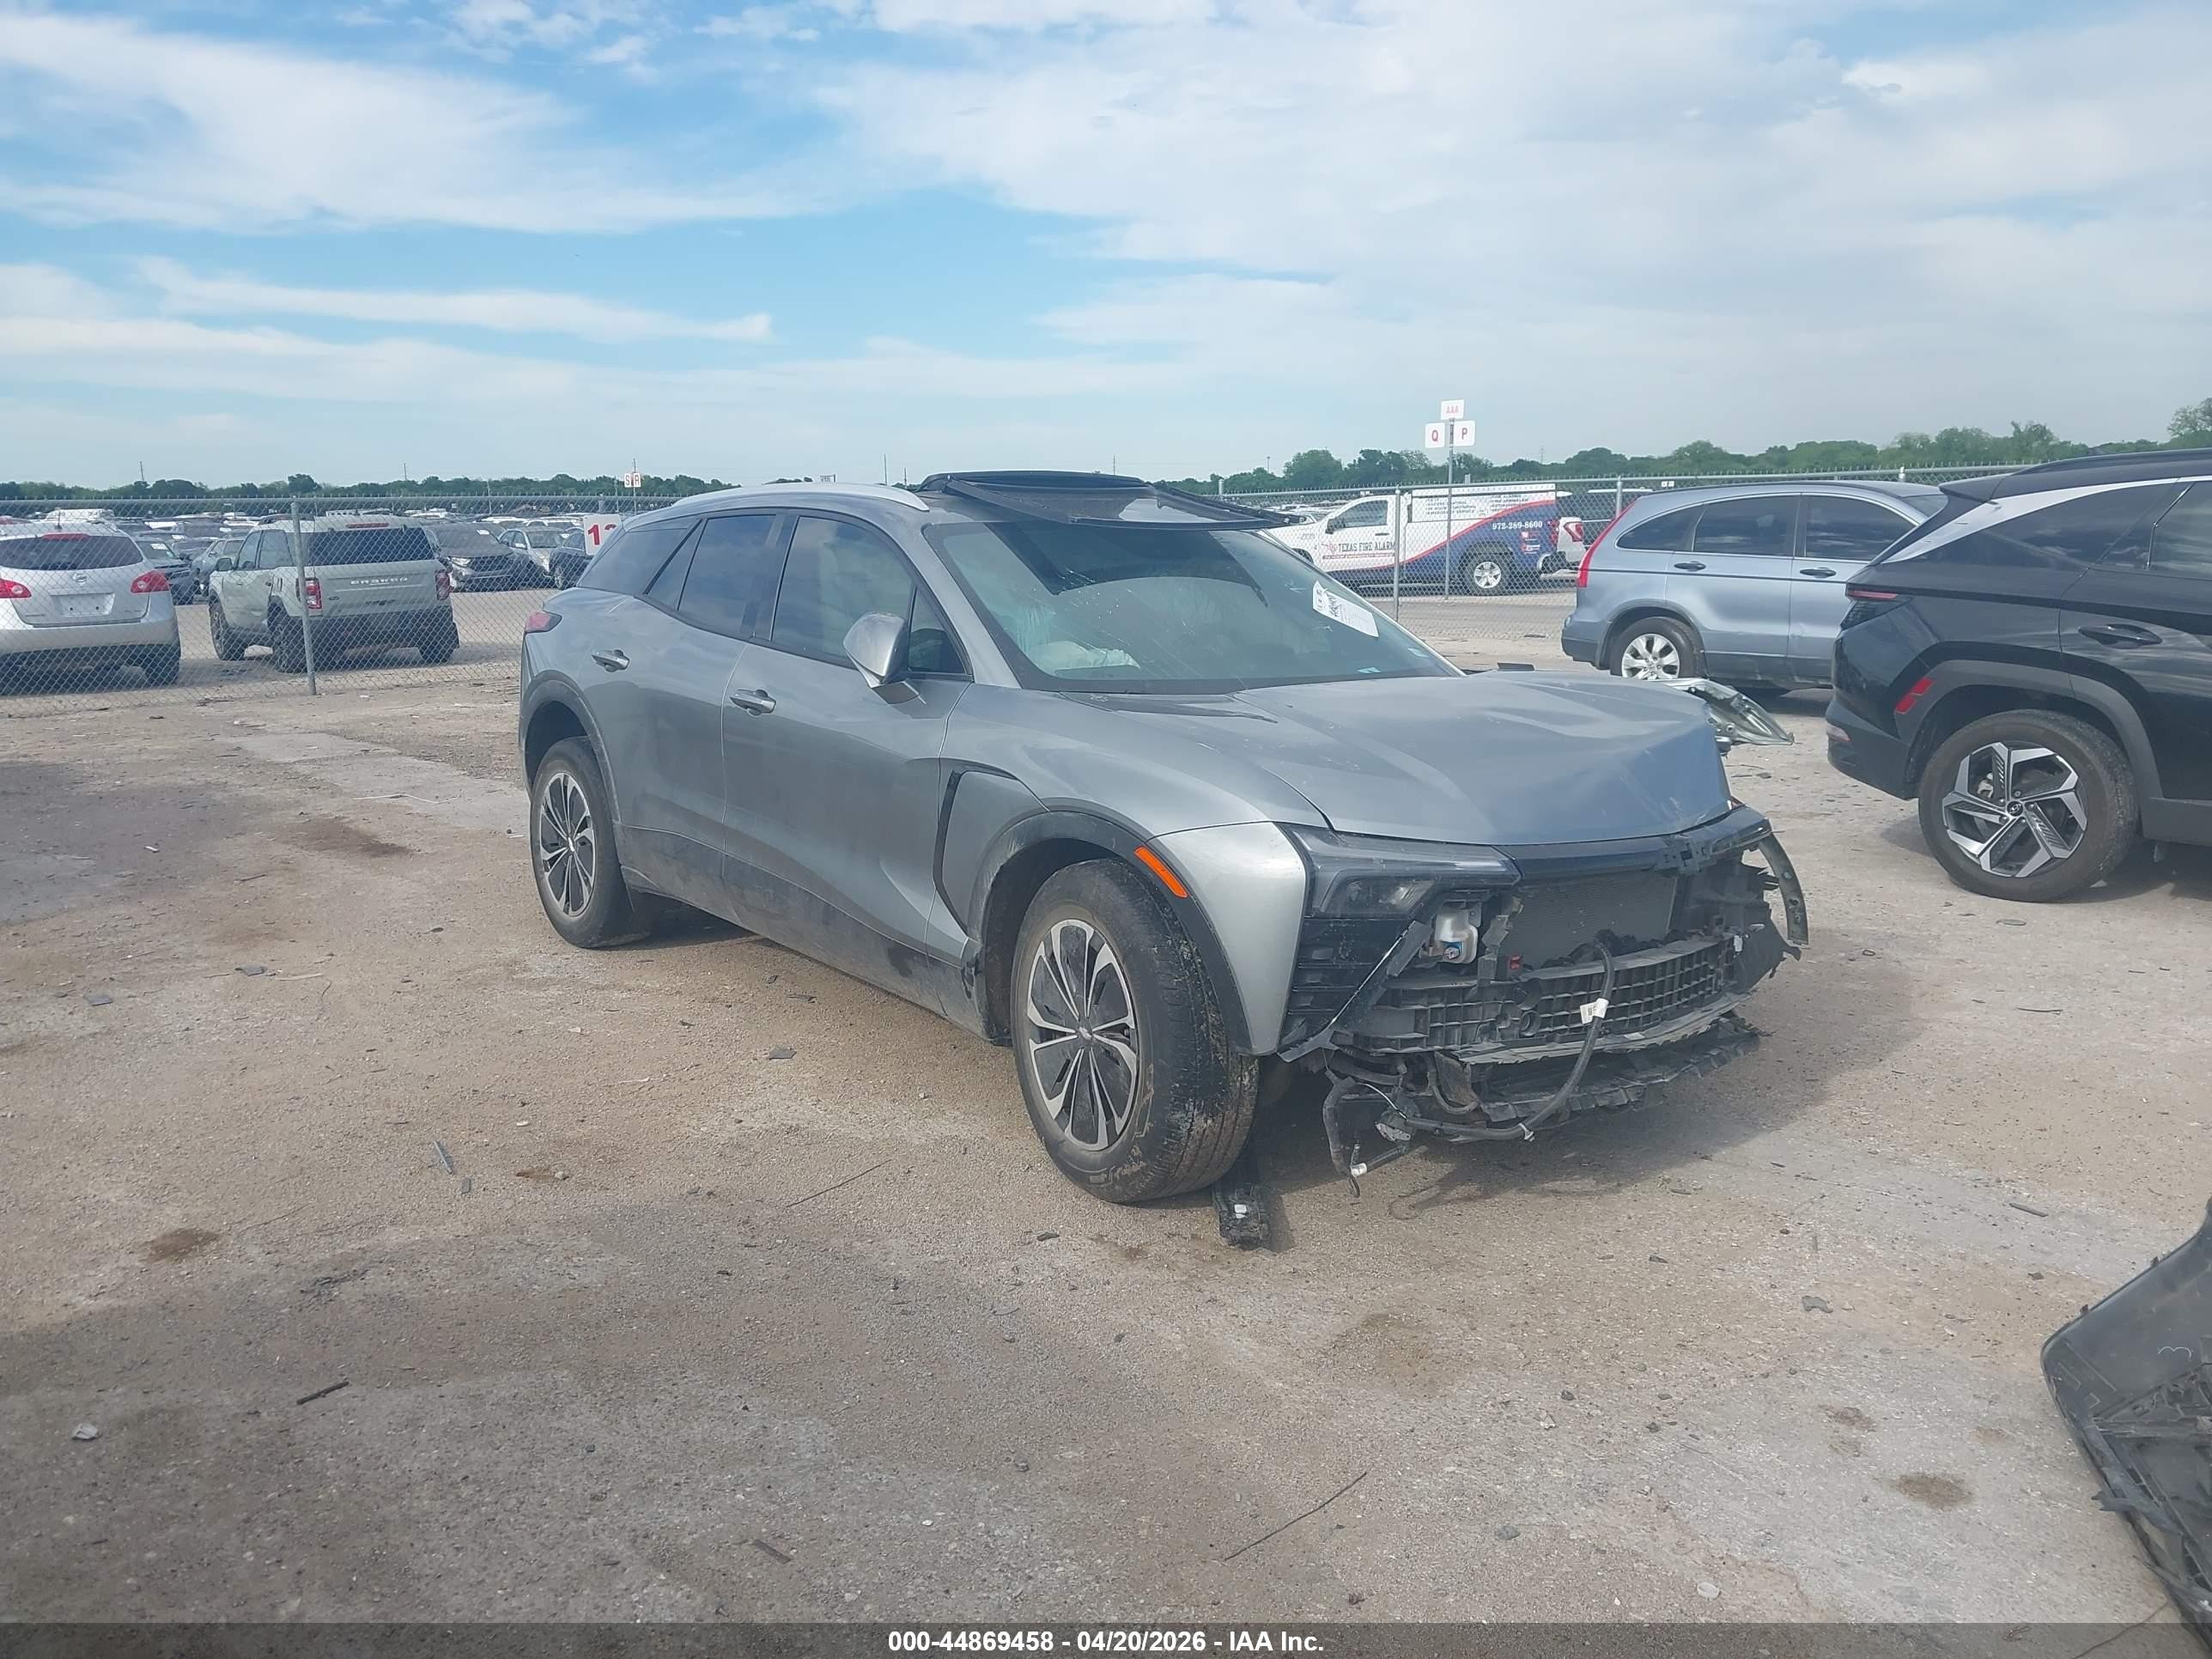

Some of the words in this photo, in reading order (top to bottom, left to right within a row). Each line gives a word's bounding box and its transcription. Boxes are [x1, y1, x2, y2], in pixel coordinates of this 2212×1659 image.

[1431, 429, 1439, 441] Q
[1462, 427, 1468, 440] P
[625, 474, 630, 486] S
[587, 524, 617, 545] 1
[1338, 543, 1358, 552] TEXAS
[1358, 542, 1373, 551] FIRE
